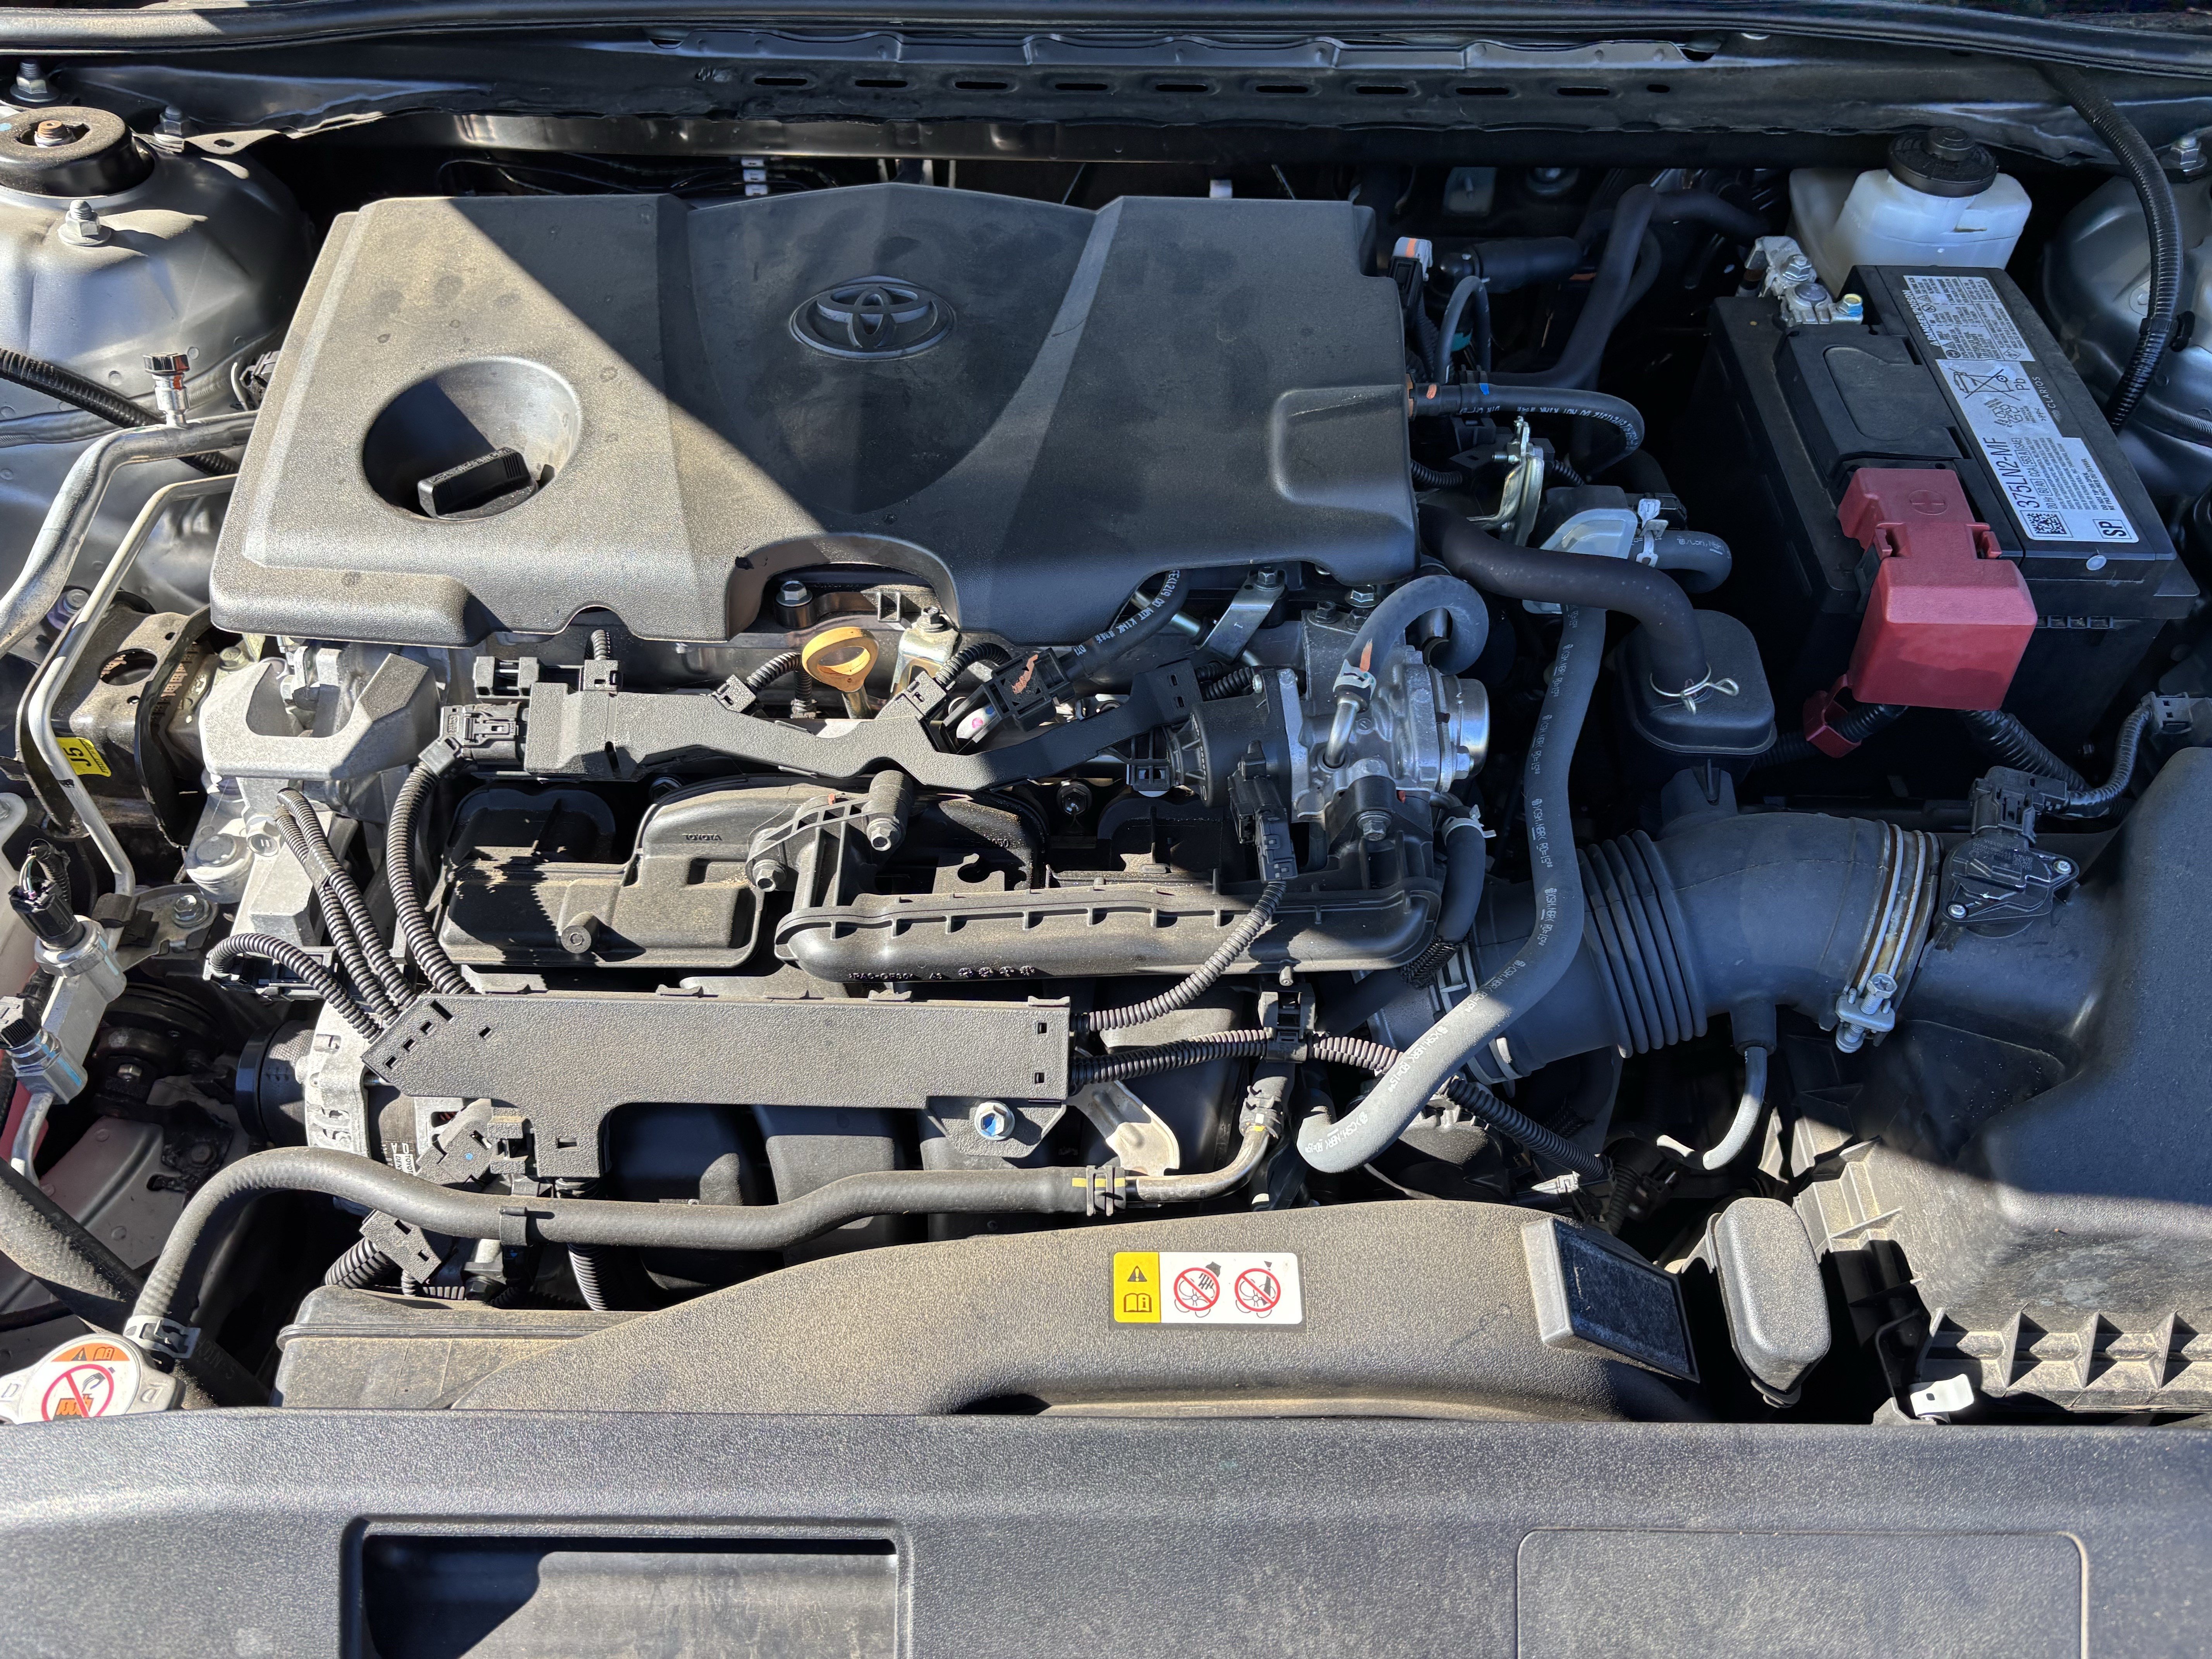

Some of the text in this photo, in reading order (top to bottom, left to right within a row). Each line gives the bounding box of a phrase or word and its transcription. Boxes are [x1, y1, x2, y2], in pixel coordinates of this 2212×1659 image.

[1903, 290, 1936, 340] DANGER/POISON
[2015, 378, 2031, 390] Pb
[2032, 376, 2057, 408] CLARIOS
[1983, 437, 2040, 508] 375LN2-MF
[2027, 467, 2040, 476] CCA
[2098, 521, 2127, 537] SP
[1138, 607, 1154, 620] NOT
[1116, 618, 1137, 634] KINK
[62, 747, 92, 768] J5
[405, 1155, 413, 1173] TOYOT
